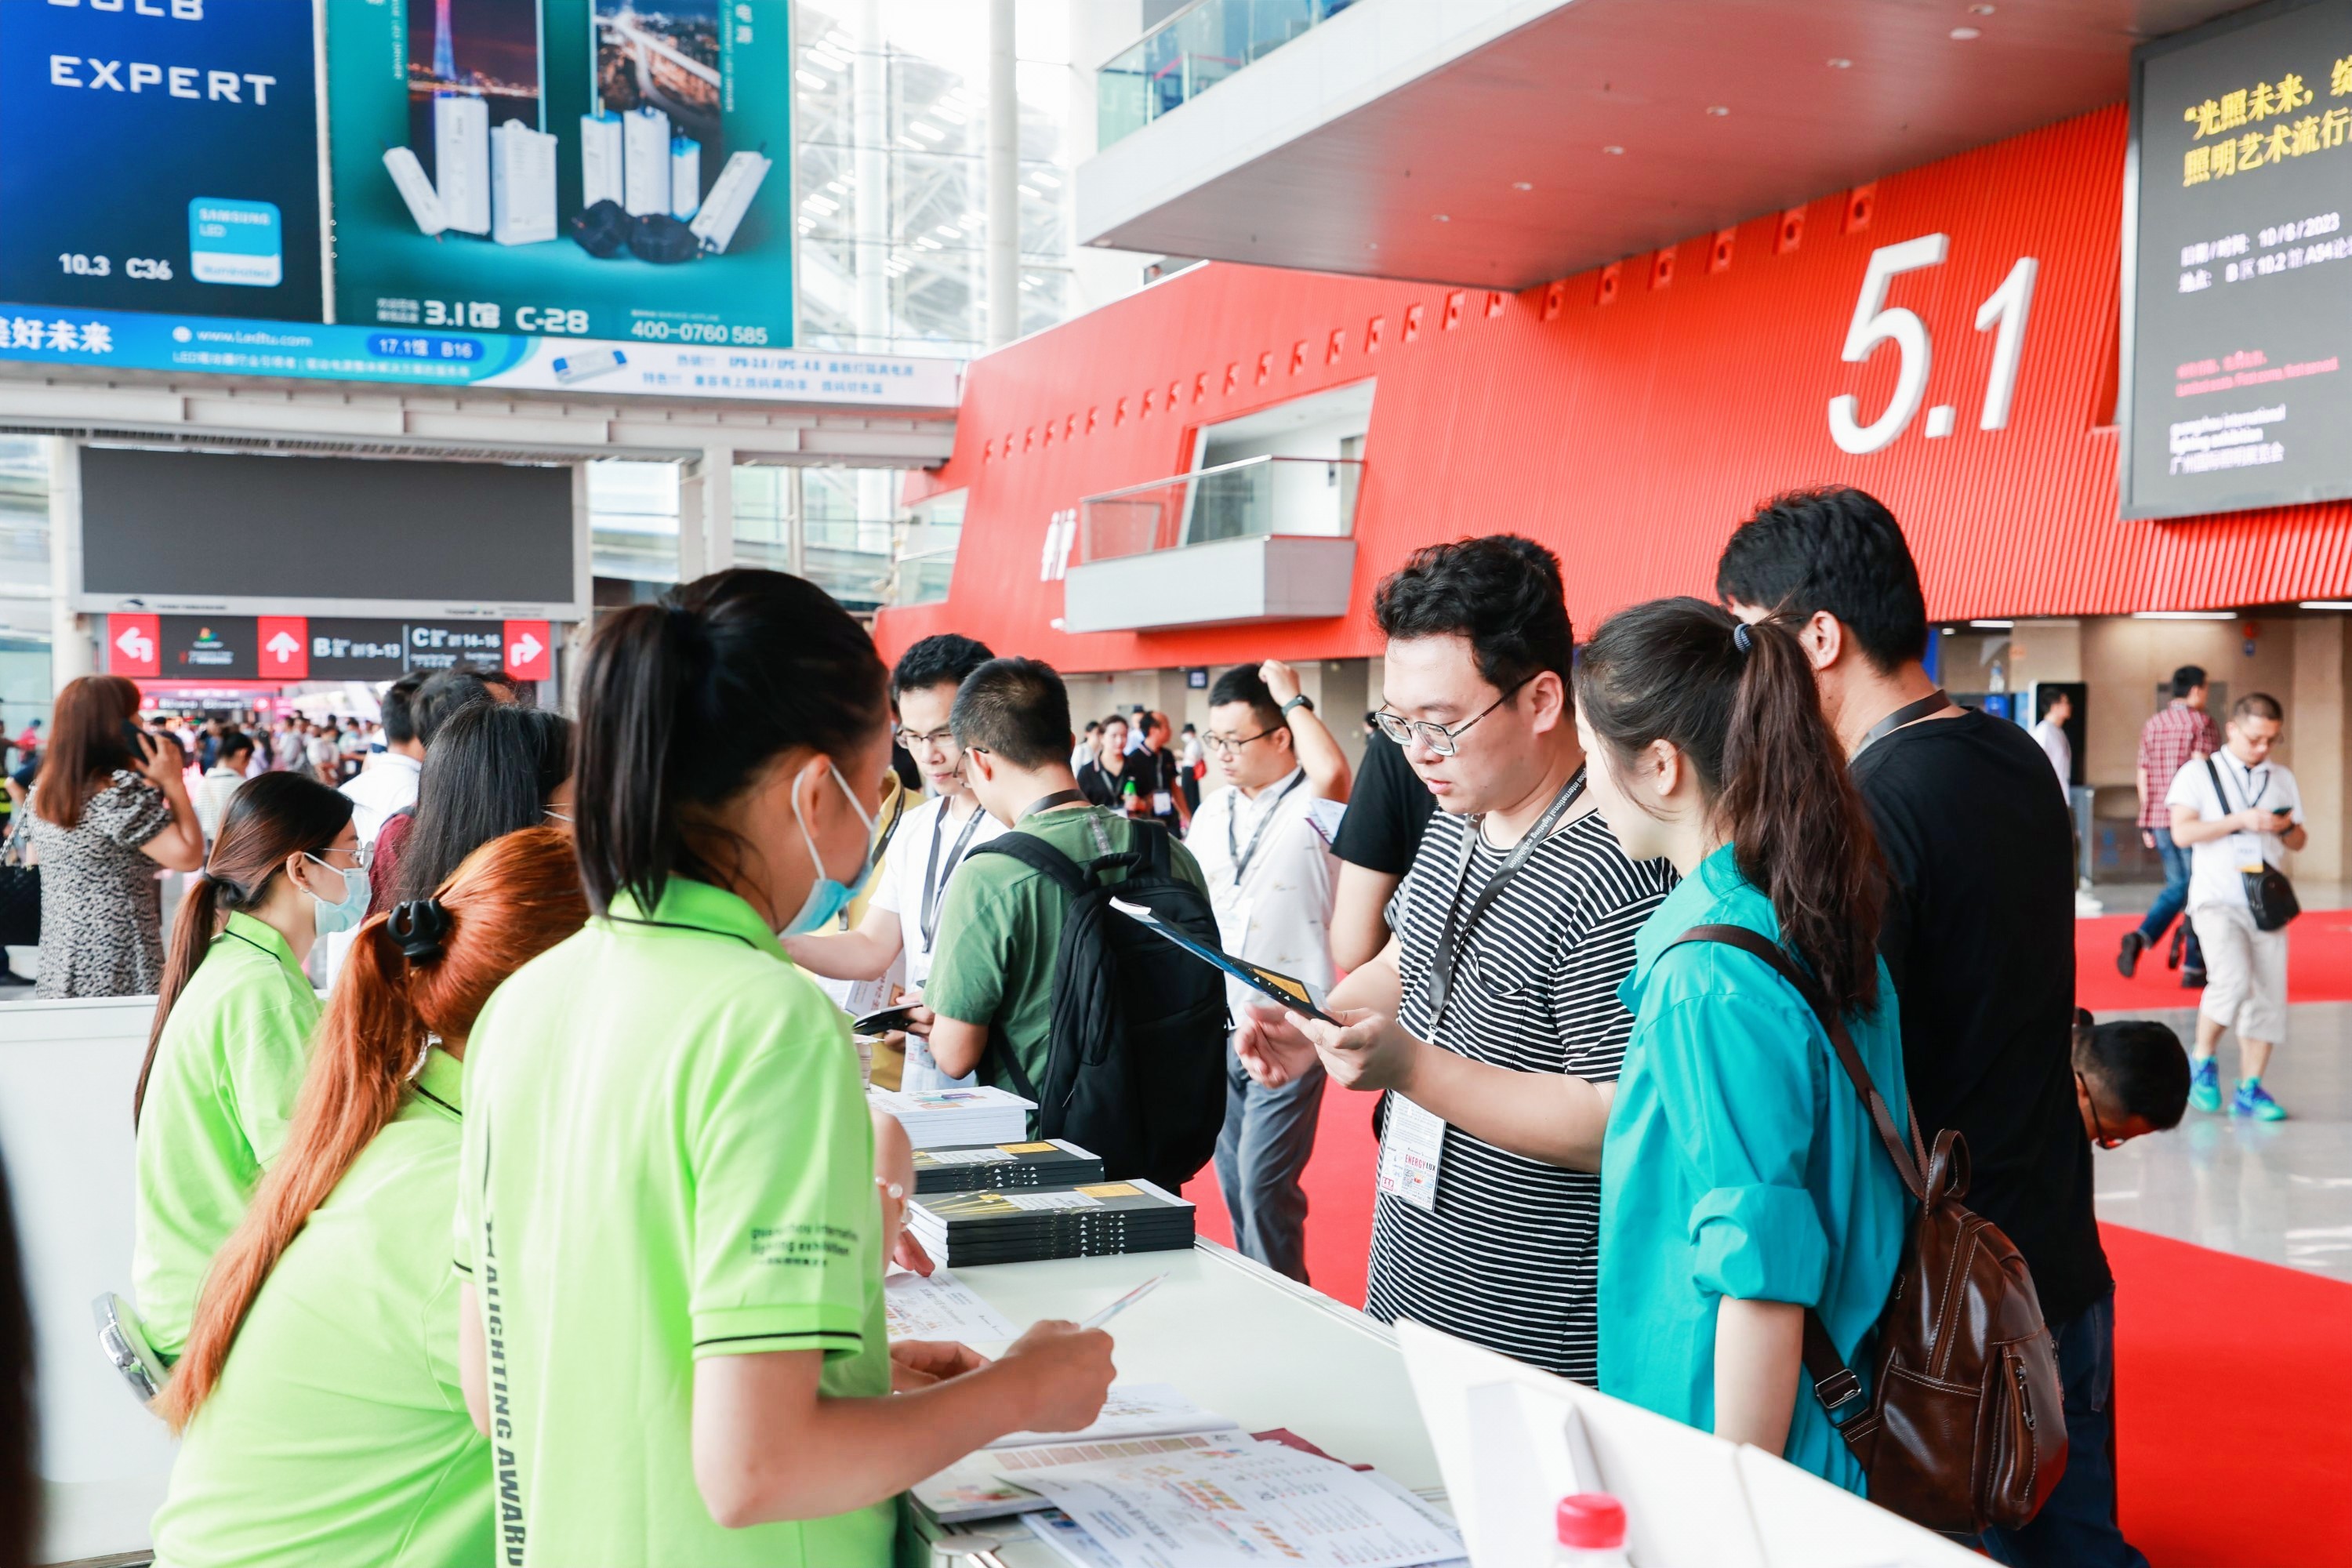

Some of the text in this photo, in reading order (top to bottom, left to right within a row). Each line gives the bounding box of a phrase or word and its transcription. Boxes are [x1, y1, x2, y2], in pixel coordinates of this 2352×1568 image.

[50, 55, 277, 106] EXPERT
[2183, 107, 2352, 187] 照明艺术流行
[199, 208, 271, 227] SAMSUNG
[199, 223, 227, 238] LED
[59, 252, 173, 281] 10.3 C36
[515, 306, 590, 333] C-28
[630, 320, 769, 345] 400-0760 585
[441, 341, 474, 359] B16
[1828, 232, 2038, 454] 5.1
[1548, 781, 1581, 817] international
[1530, 815, 1555, 840] lighting
[1508, 838, 1534, 869] exhibition
[497, 1446, 526, 1567] AWARD
